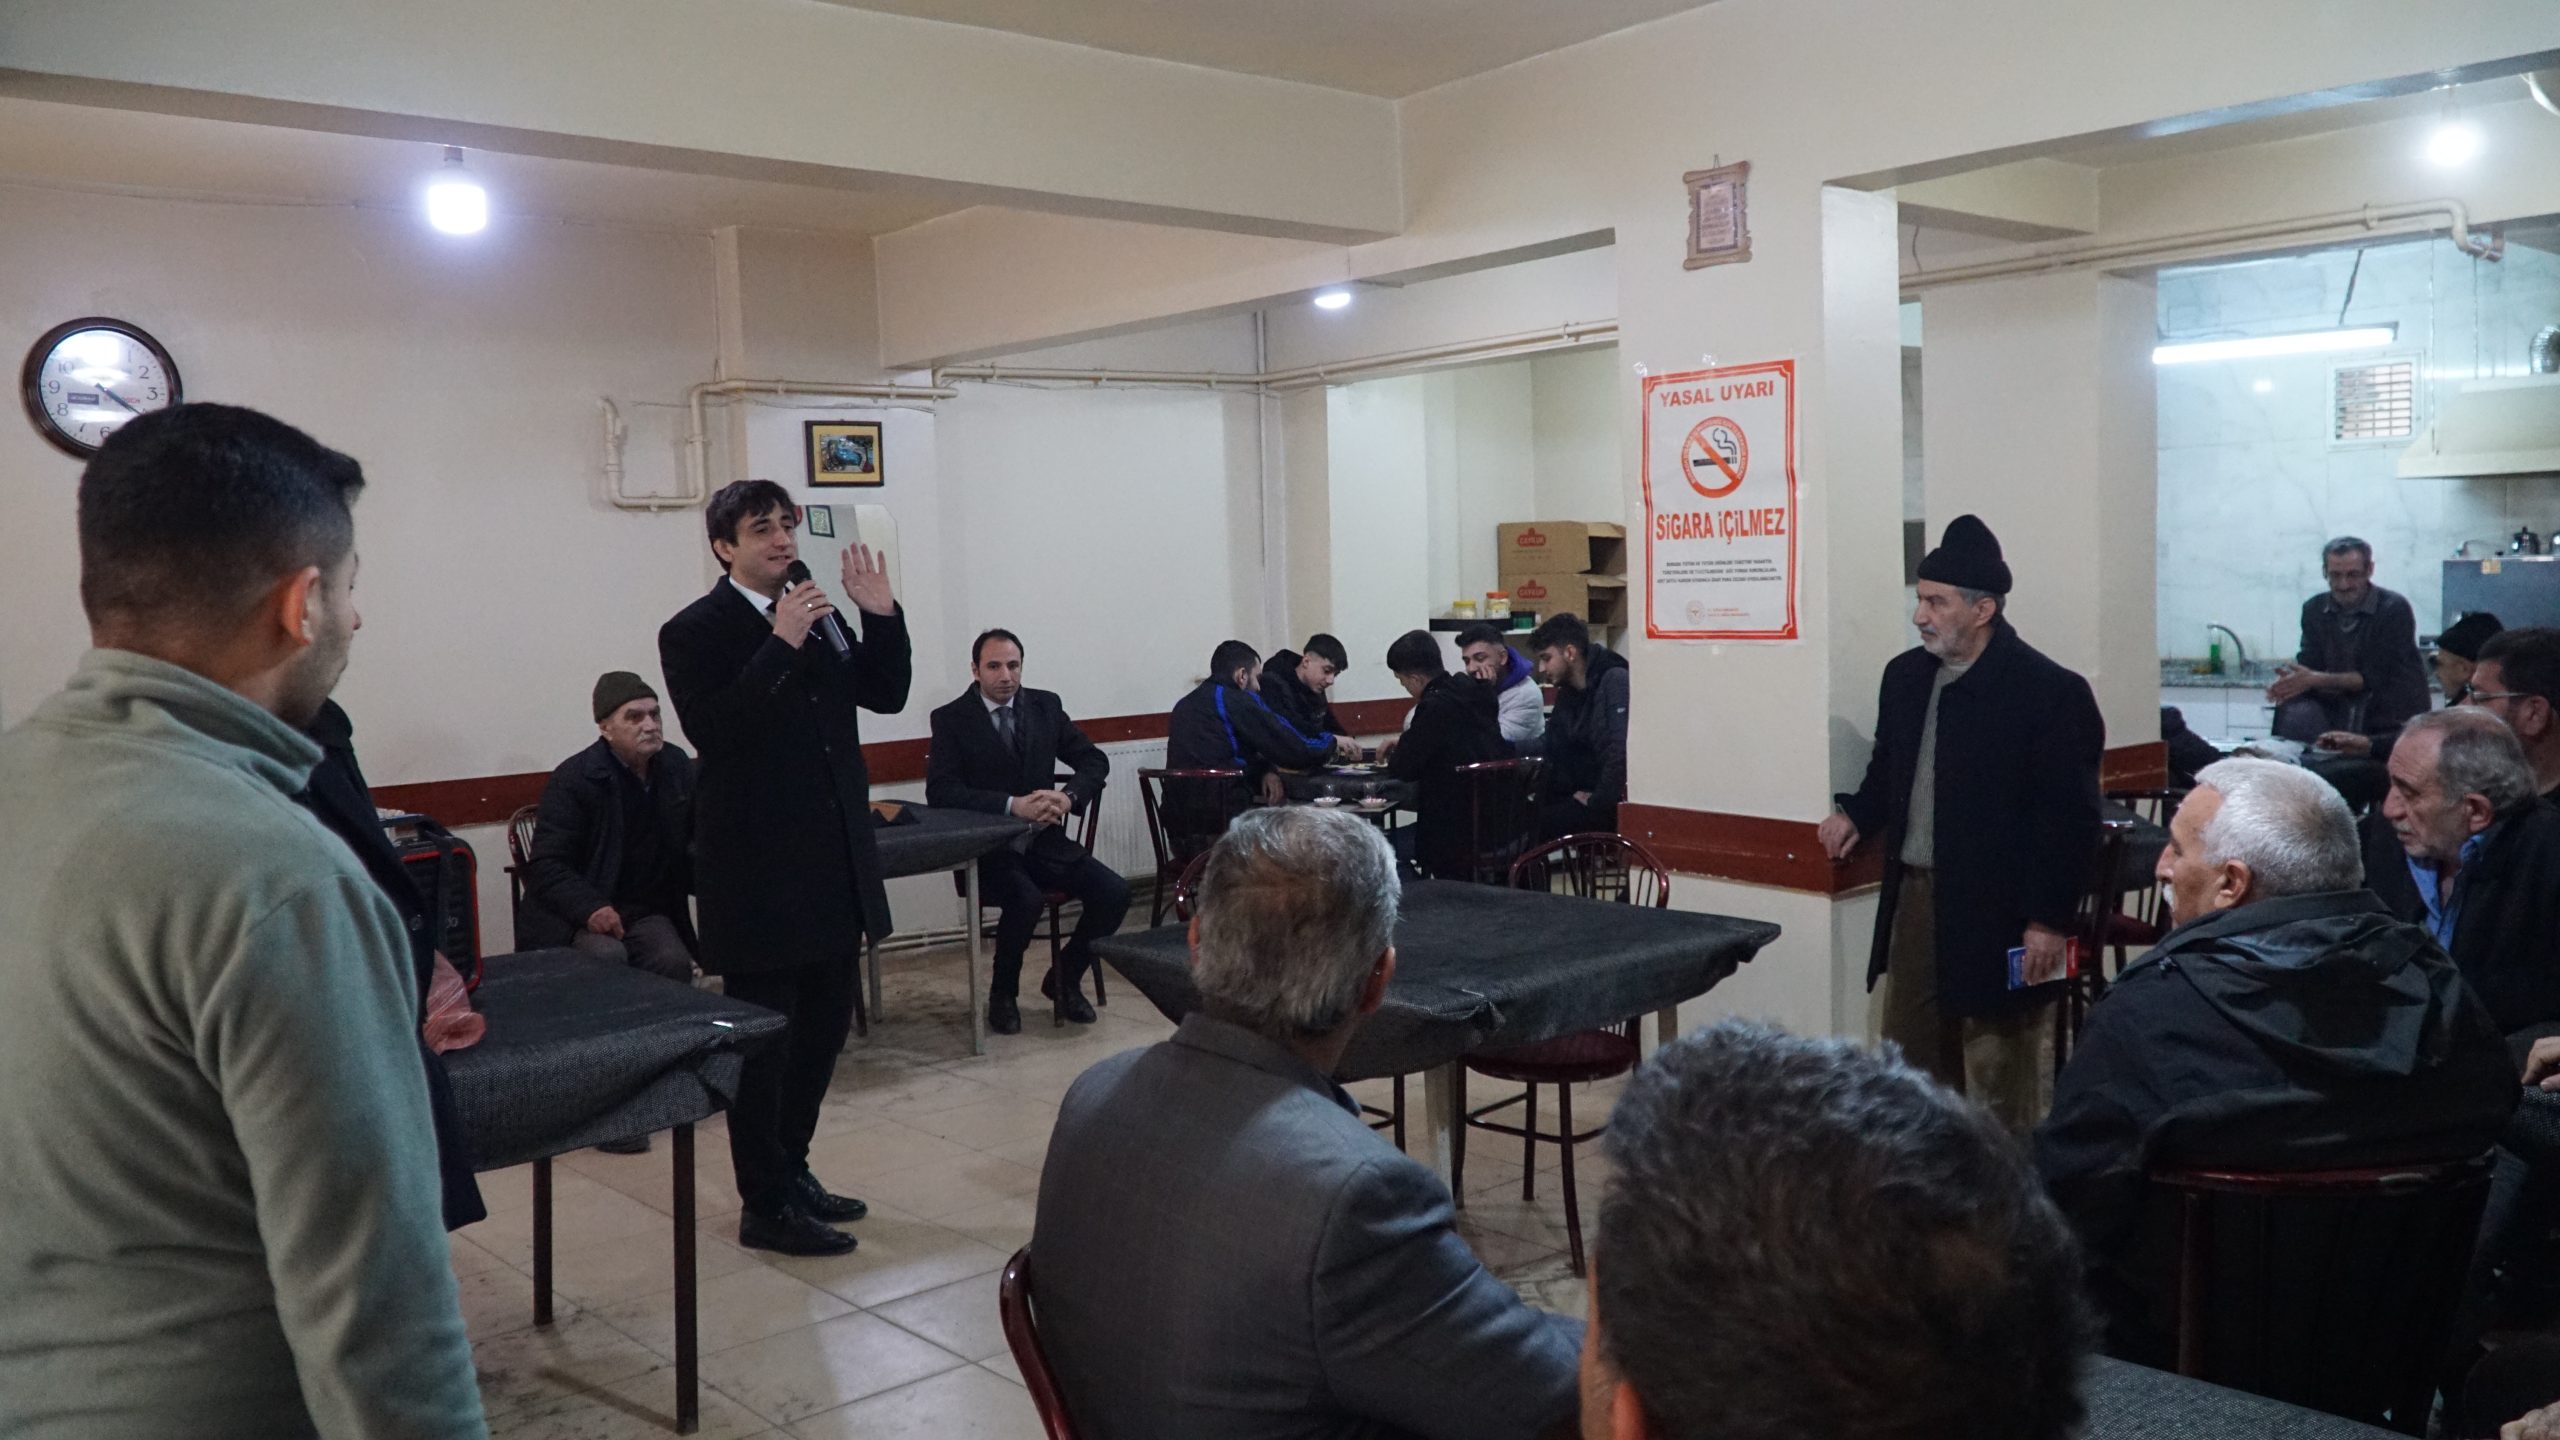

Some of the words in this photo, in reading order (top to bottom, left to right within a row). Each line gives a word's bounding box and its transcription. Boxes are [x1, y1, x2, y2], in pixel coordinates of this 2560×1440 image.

[138, 366, 149, 379] 2
[48, 380, 60, 394] 9
[146, 387, 158, 400] 3
[1660, 387, 1714, 407] YASAL
[1721, 380, 1774, 401] UYARI
[57, 402, 68, 416] 8
